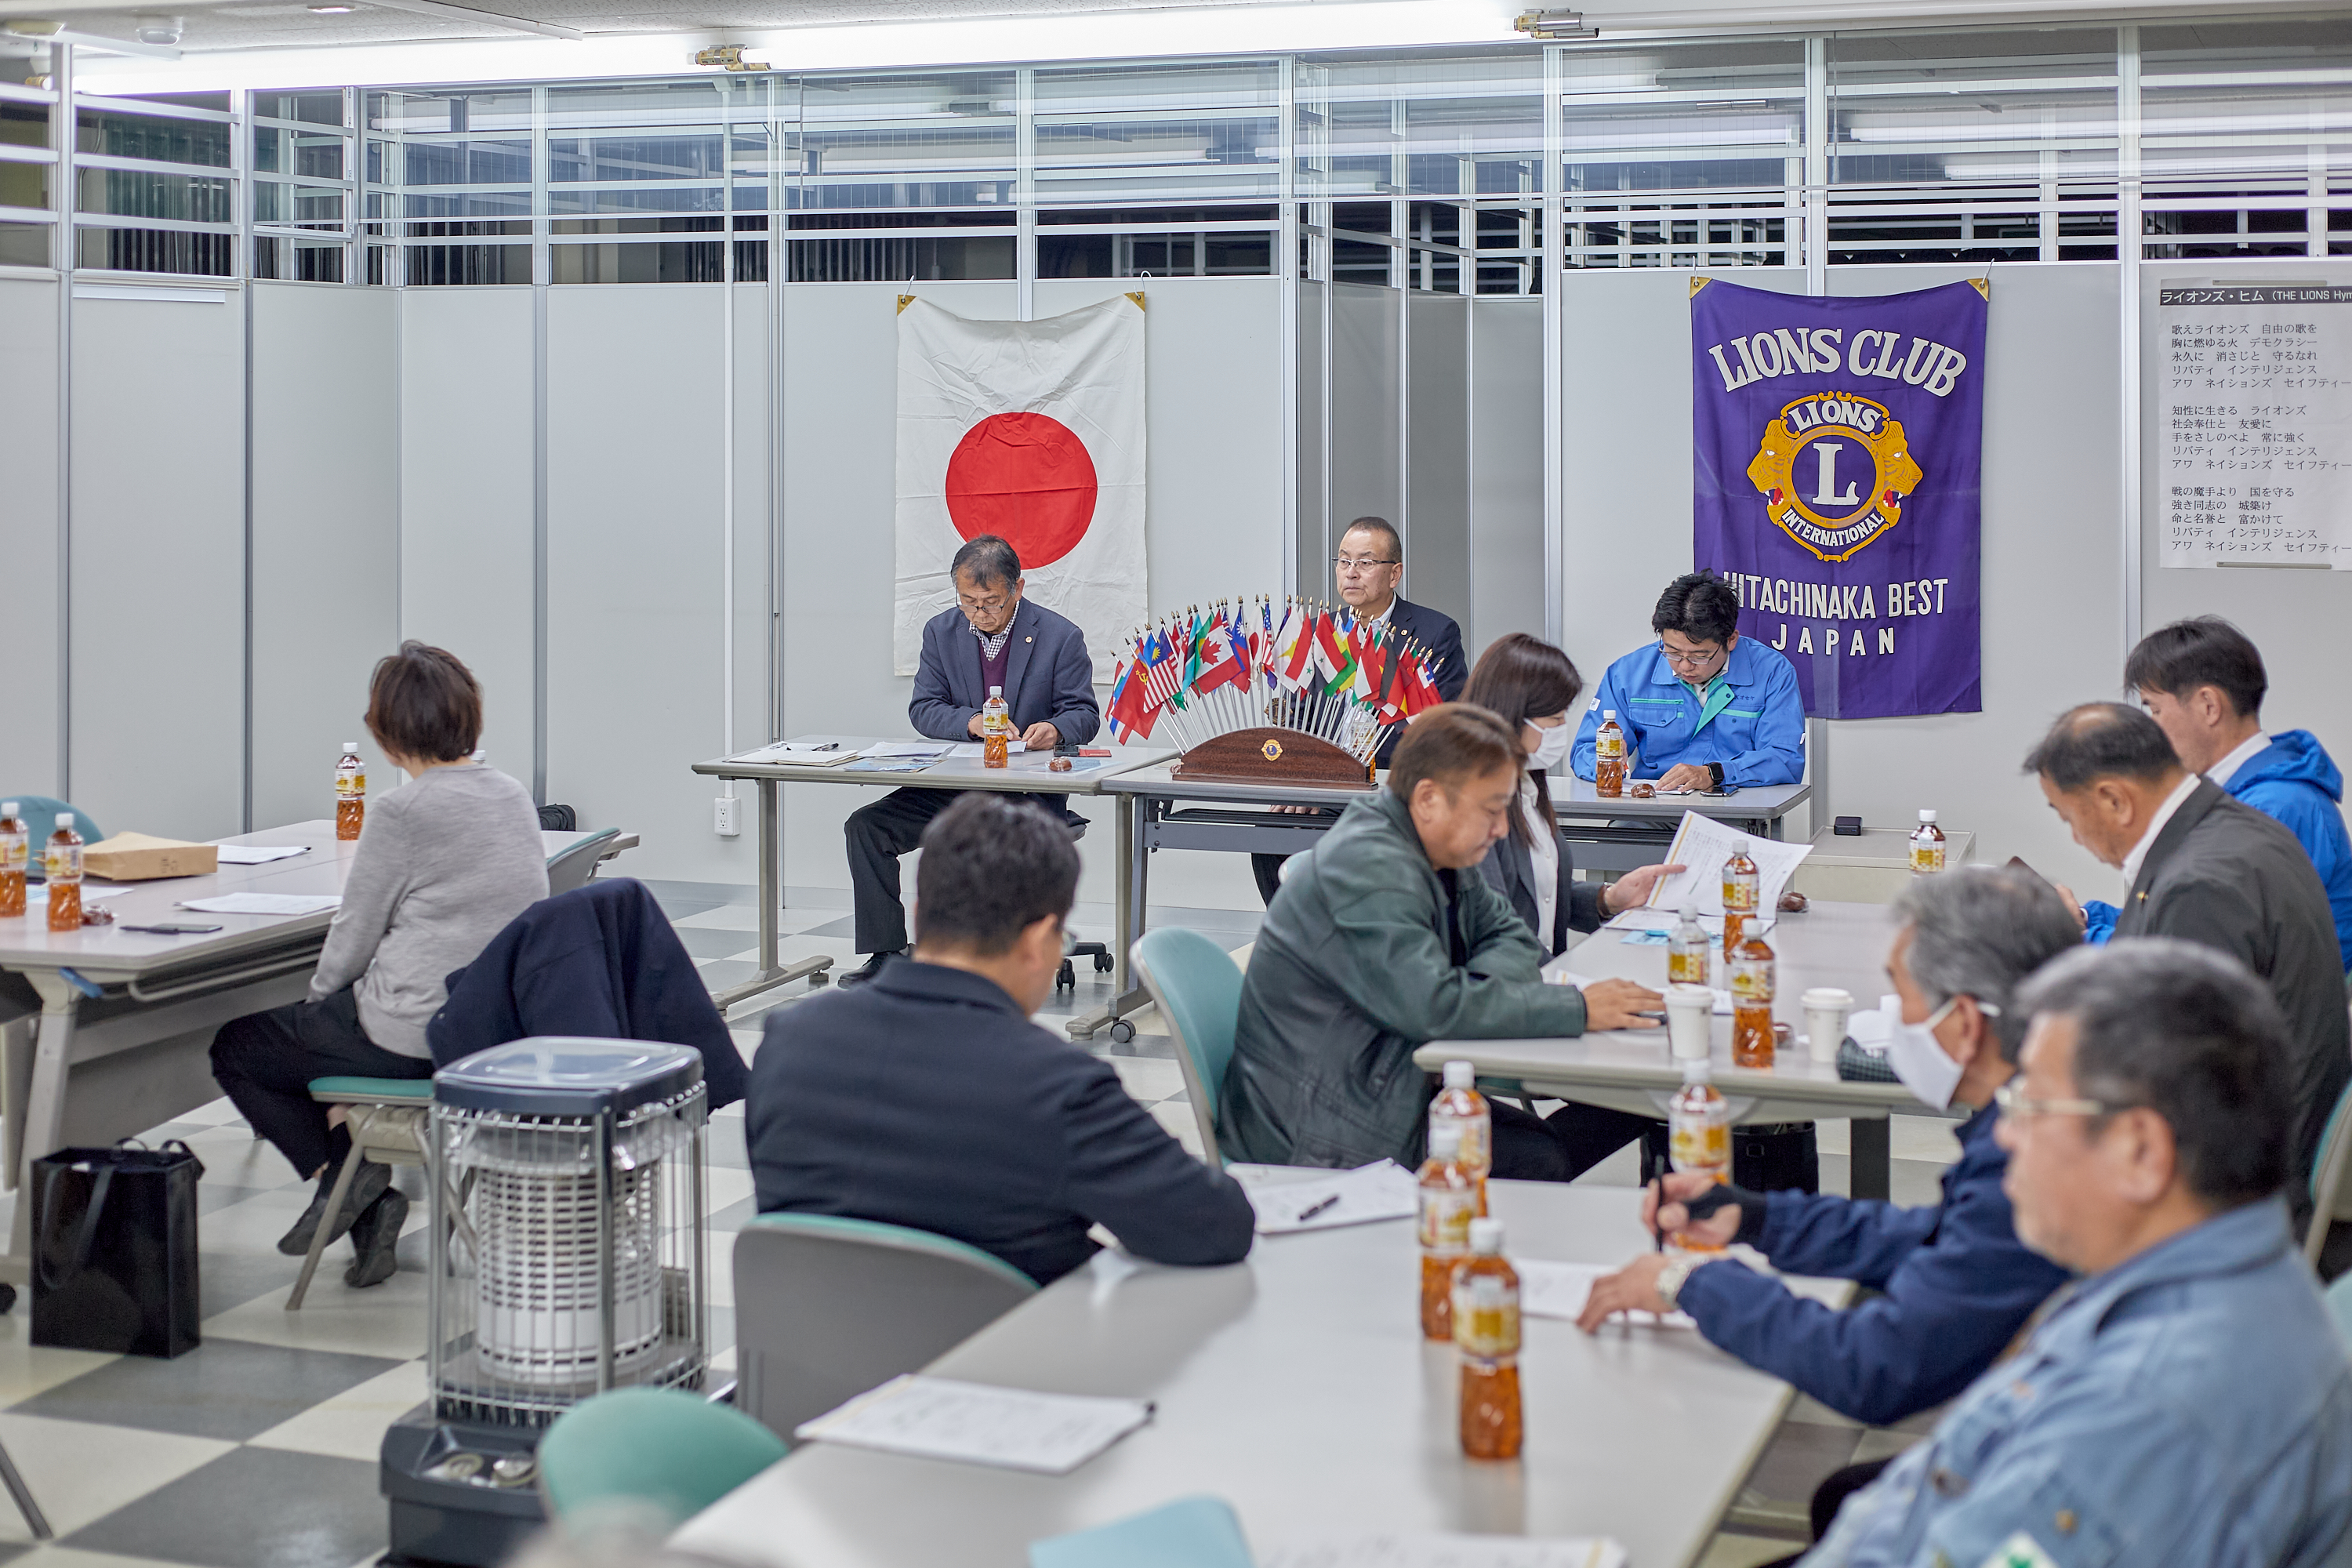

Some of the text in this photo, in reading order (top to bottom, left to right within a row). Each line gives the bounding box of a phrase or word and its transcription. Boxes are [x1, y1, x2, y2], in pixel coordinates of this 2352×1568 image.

[2161, 291, 2264, 303] ライオンズ・ヒム
[2300, 290, 2330, 300] LIONS
[2172, 324, 2317, 335] 歌えライオンズ 自由の歌を
[2172, 337, 2317, 348] 胸に燃ゆる火 デモクラシー
[2172, 350, 2318, 361] 永久に 消さじと 守るなれ
[1708, 328, 1967, 397] LIONS CLUB
[2173, 365, 2317, 375] リバティ インテリジェンス
[2172, 378, 2351, 388] アワ ネイションズ セイフティー
[1788, 400, 1882, 432] LIONS
[2172, 405, 2307, 416] 知性に生きる ライオンズ
[2172, 419, 2271, 429] 社会奉仕と 友愛に
[2172, 432, 2303, 442] 手をさしのべよ 常に強く
[2173, 446, 2317, 456] リバティ インテリジェンス
[2172, 459, 2351, 470] アワ ネイションズ セイフティー
[1812, 442, 1860, 506] L
[2172, 486, 2294, 497] 戦の魔手より 国を守る
[2172, 499, 2271, 510] 強き同志の 城築け
[2172, 513, 2283, 524] 命と名誉と 富かけて
[1781, 508, 1885, 546] INTERNATIONAL
[2173, 527, 2317, 539] リバティ インテリジェンス
[2172, 541, 2351, 553] アワ ネイションズ セイフティー
[1888, 578, 1949, 618] BEST
[1770, 623, 1895, 657] JAPAN
